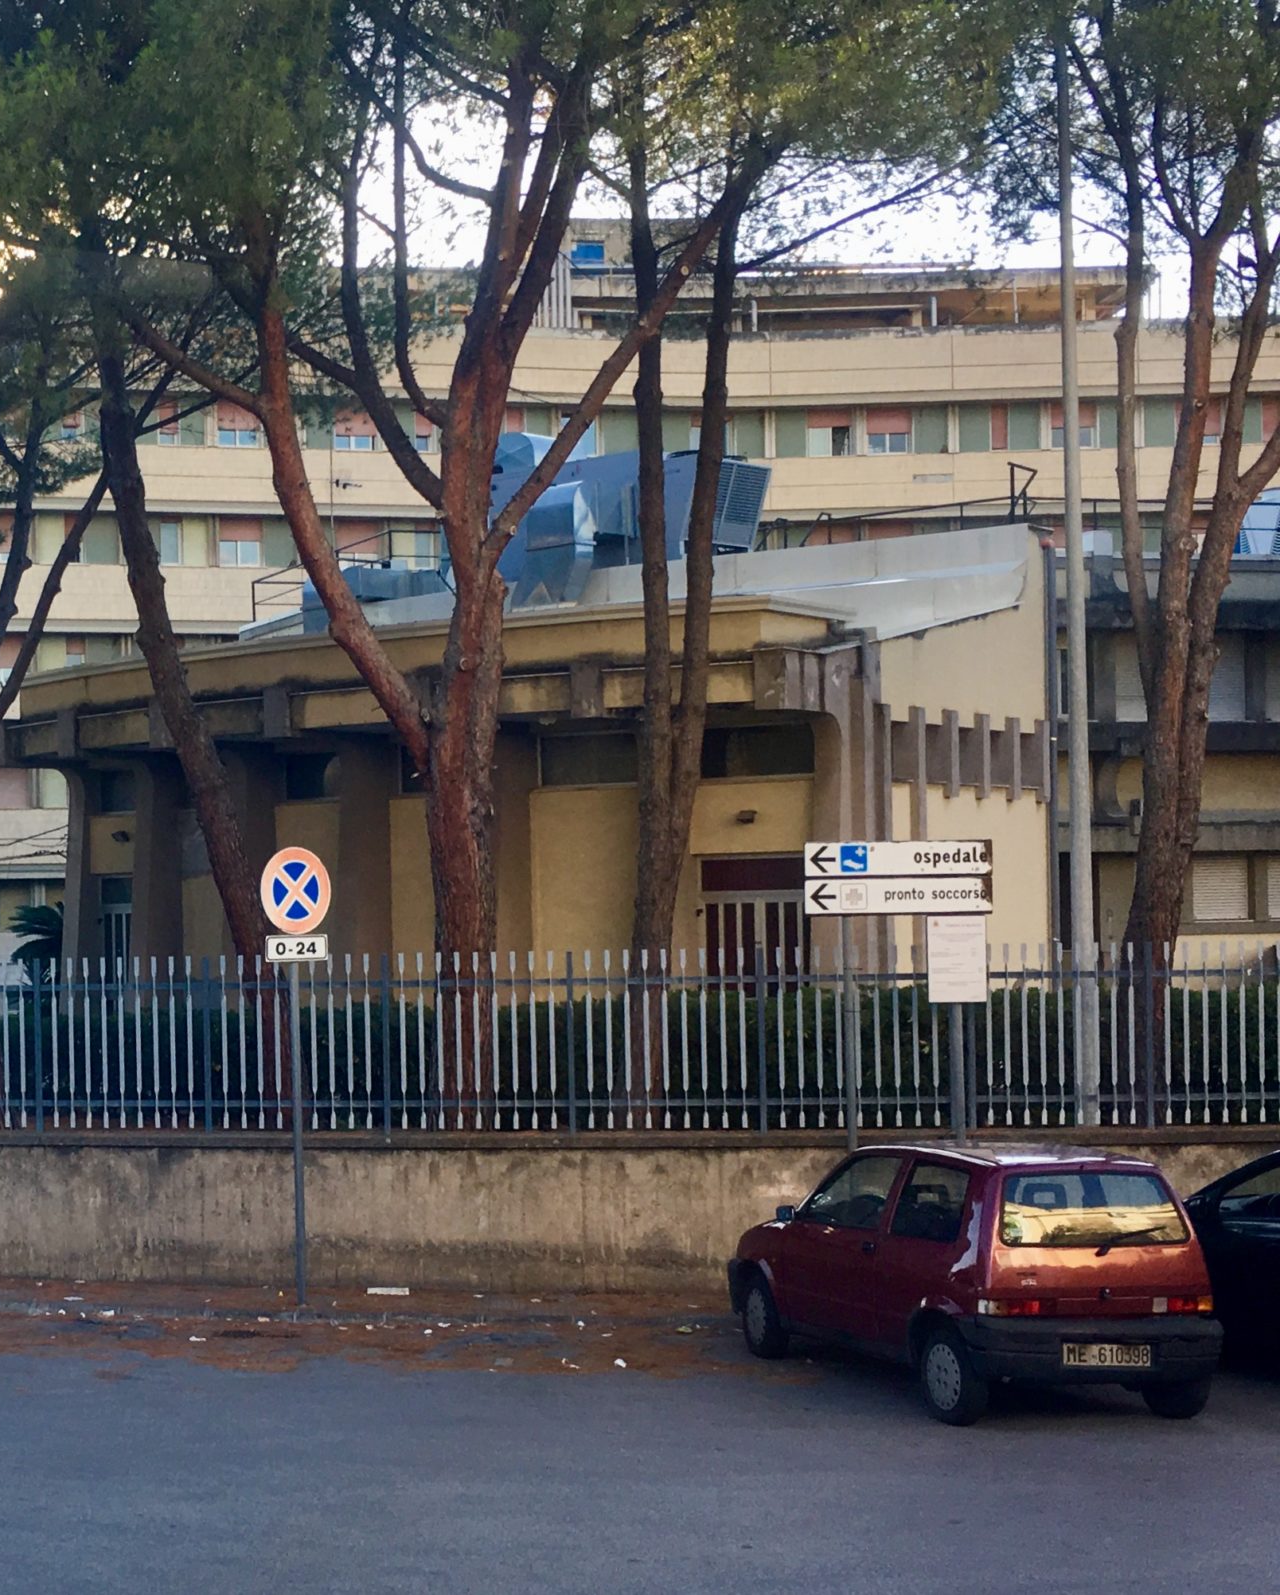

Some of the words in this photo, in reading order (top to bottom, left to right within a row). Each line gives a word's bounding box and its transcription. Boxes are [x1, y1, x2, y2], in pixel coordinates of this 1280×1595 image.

[913, 848, 988, 868] ospedale
[884, 888, 925, 902] pronto
[931, 886, 987, 900] soccorso
[1066, 1346, 1087, 1364] ME
